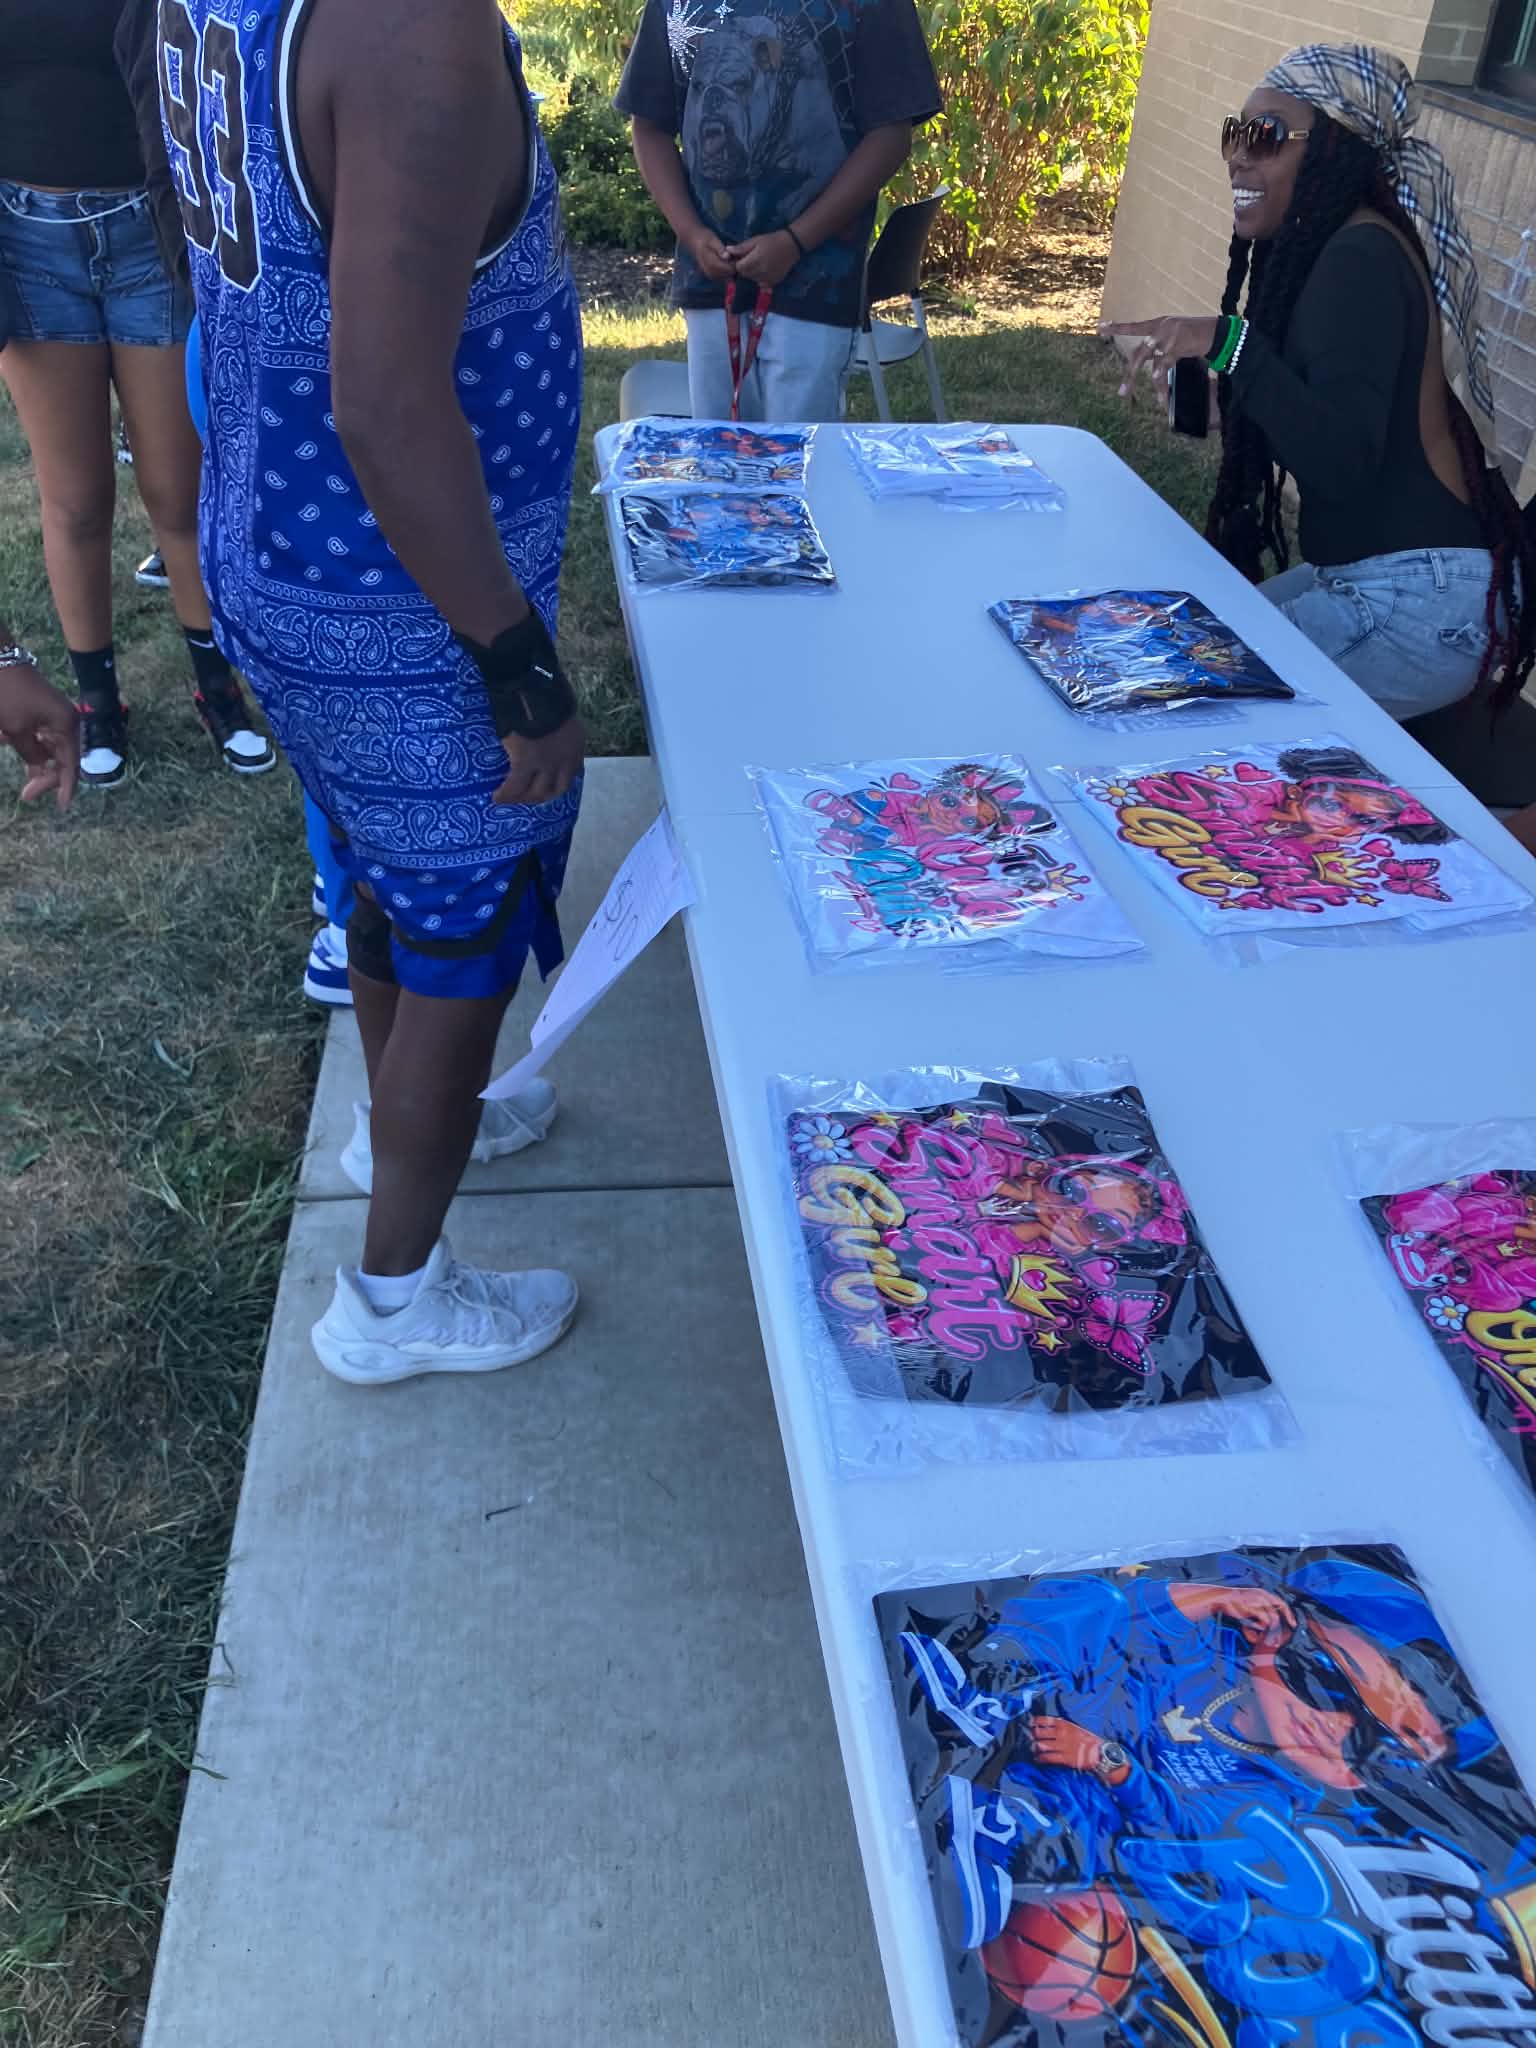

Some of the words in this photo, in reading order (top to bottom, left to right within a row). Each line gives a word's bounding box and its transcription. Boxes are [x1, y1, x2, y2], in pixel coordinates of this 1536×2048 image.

[1116, 804, 1261, 898] Girl
[1135, 769, 1352, 913] Smart
[798, 1162, 930, 1313] Girl
[850, 1121, 1033, 1355] Smart
[1162, 1749, 1201, 1791] ACHIEVE
[1182, 1754, 1211, 1782] PLAN
[1193, 1748, 1230, 1783] DREAM
[1302, 1827, 1536, 2048] Littl
